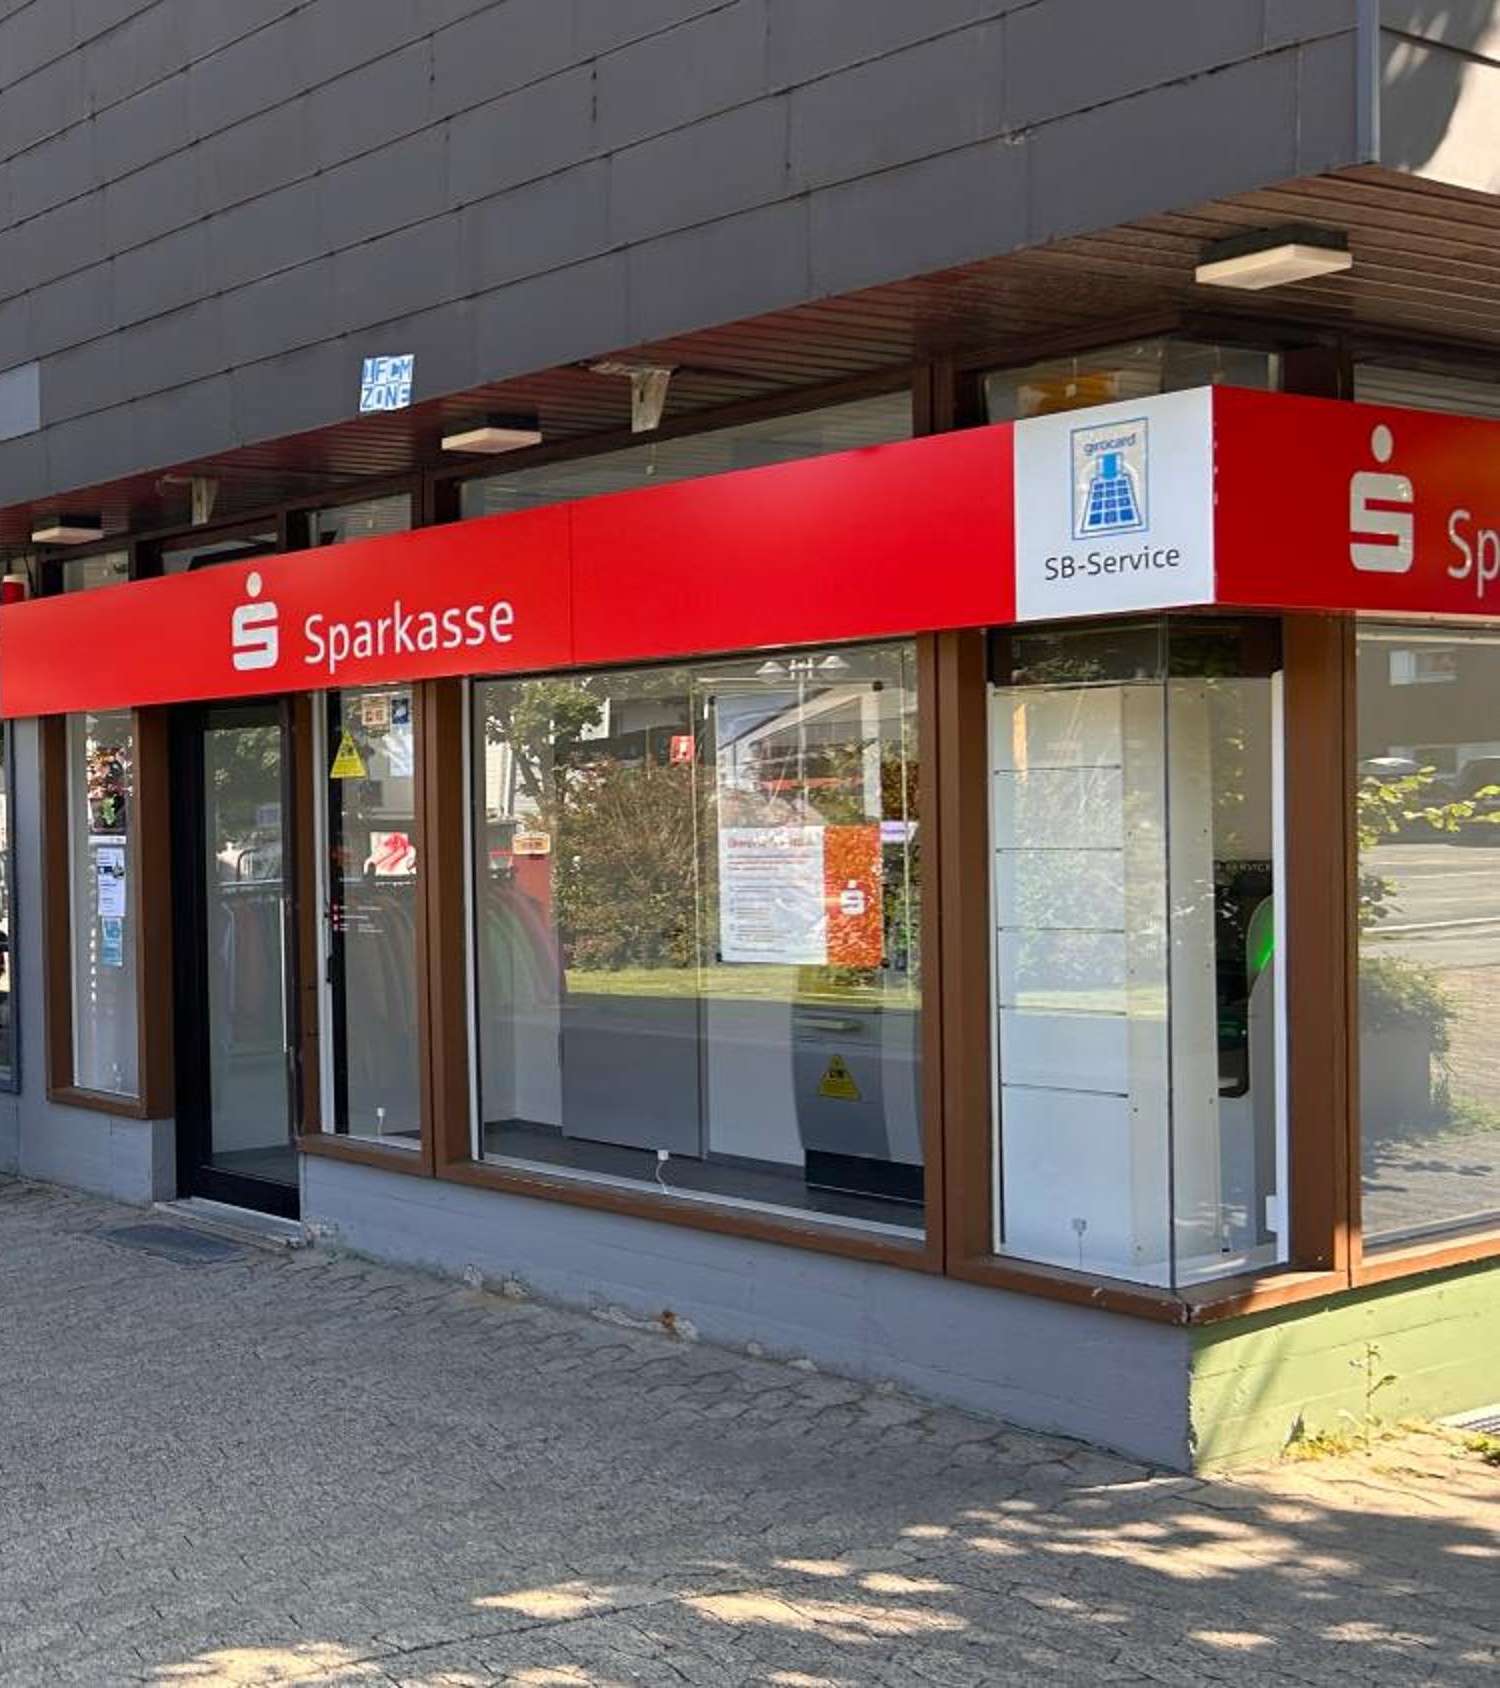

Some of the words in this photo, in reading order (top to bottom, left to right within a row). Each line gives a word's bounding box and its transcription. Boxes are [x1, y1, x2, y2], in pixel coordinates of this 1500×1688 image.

[361, 384, 410, 409] ZONE
[1044, 545, 1181, 581] SB-Service
[303, 600, 515, 674] Sparkasse
